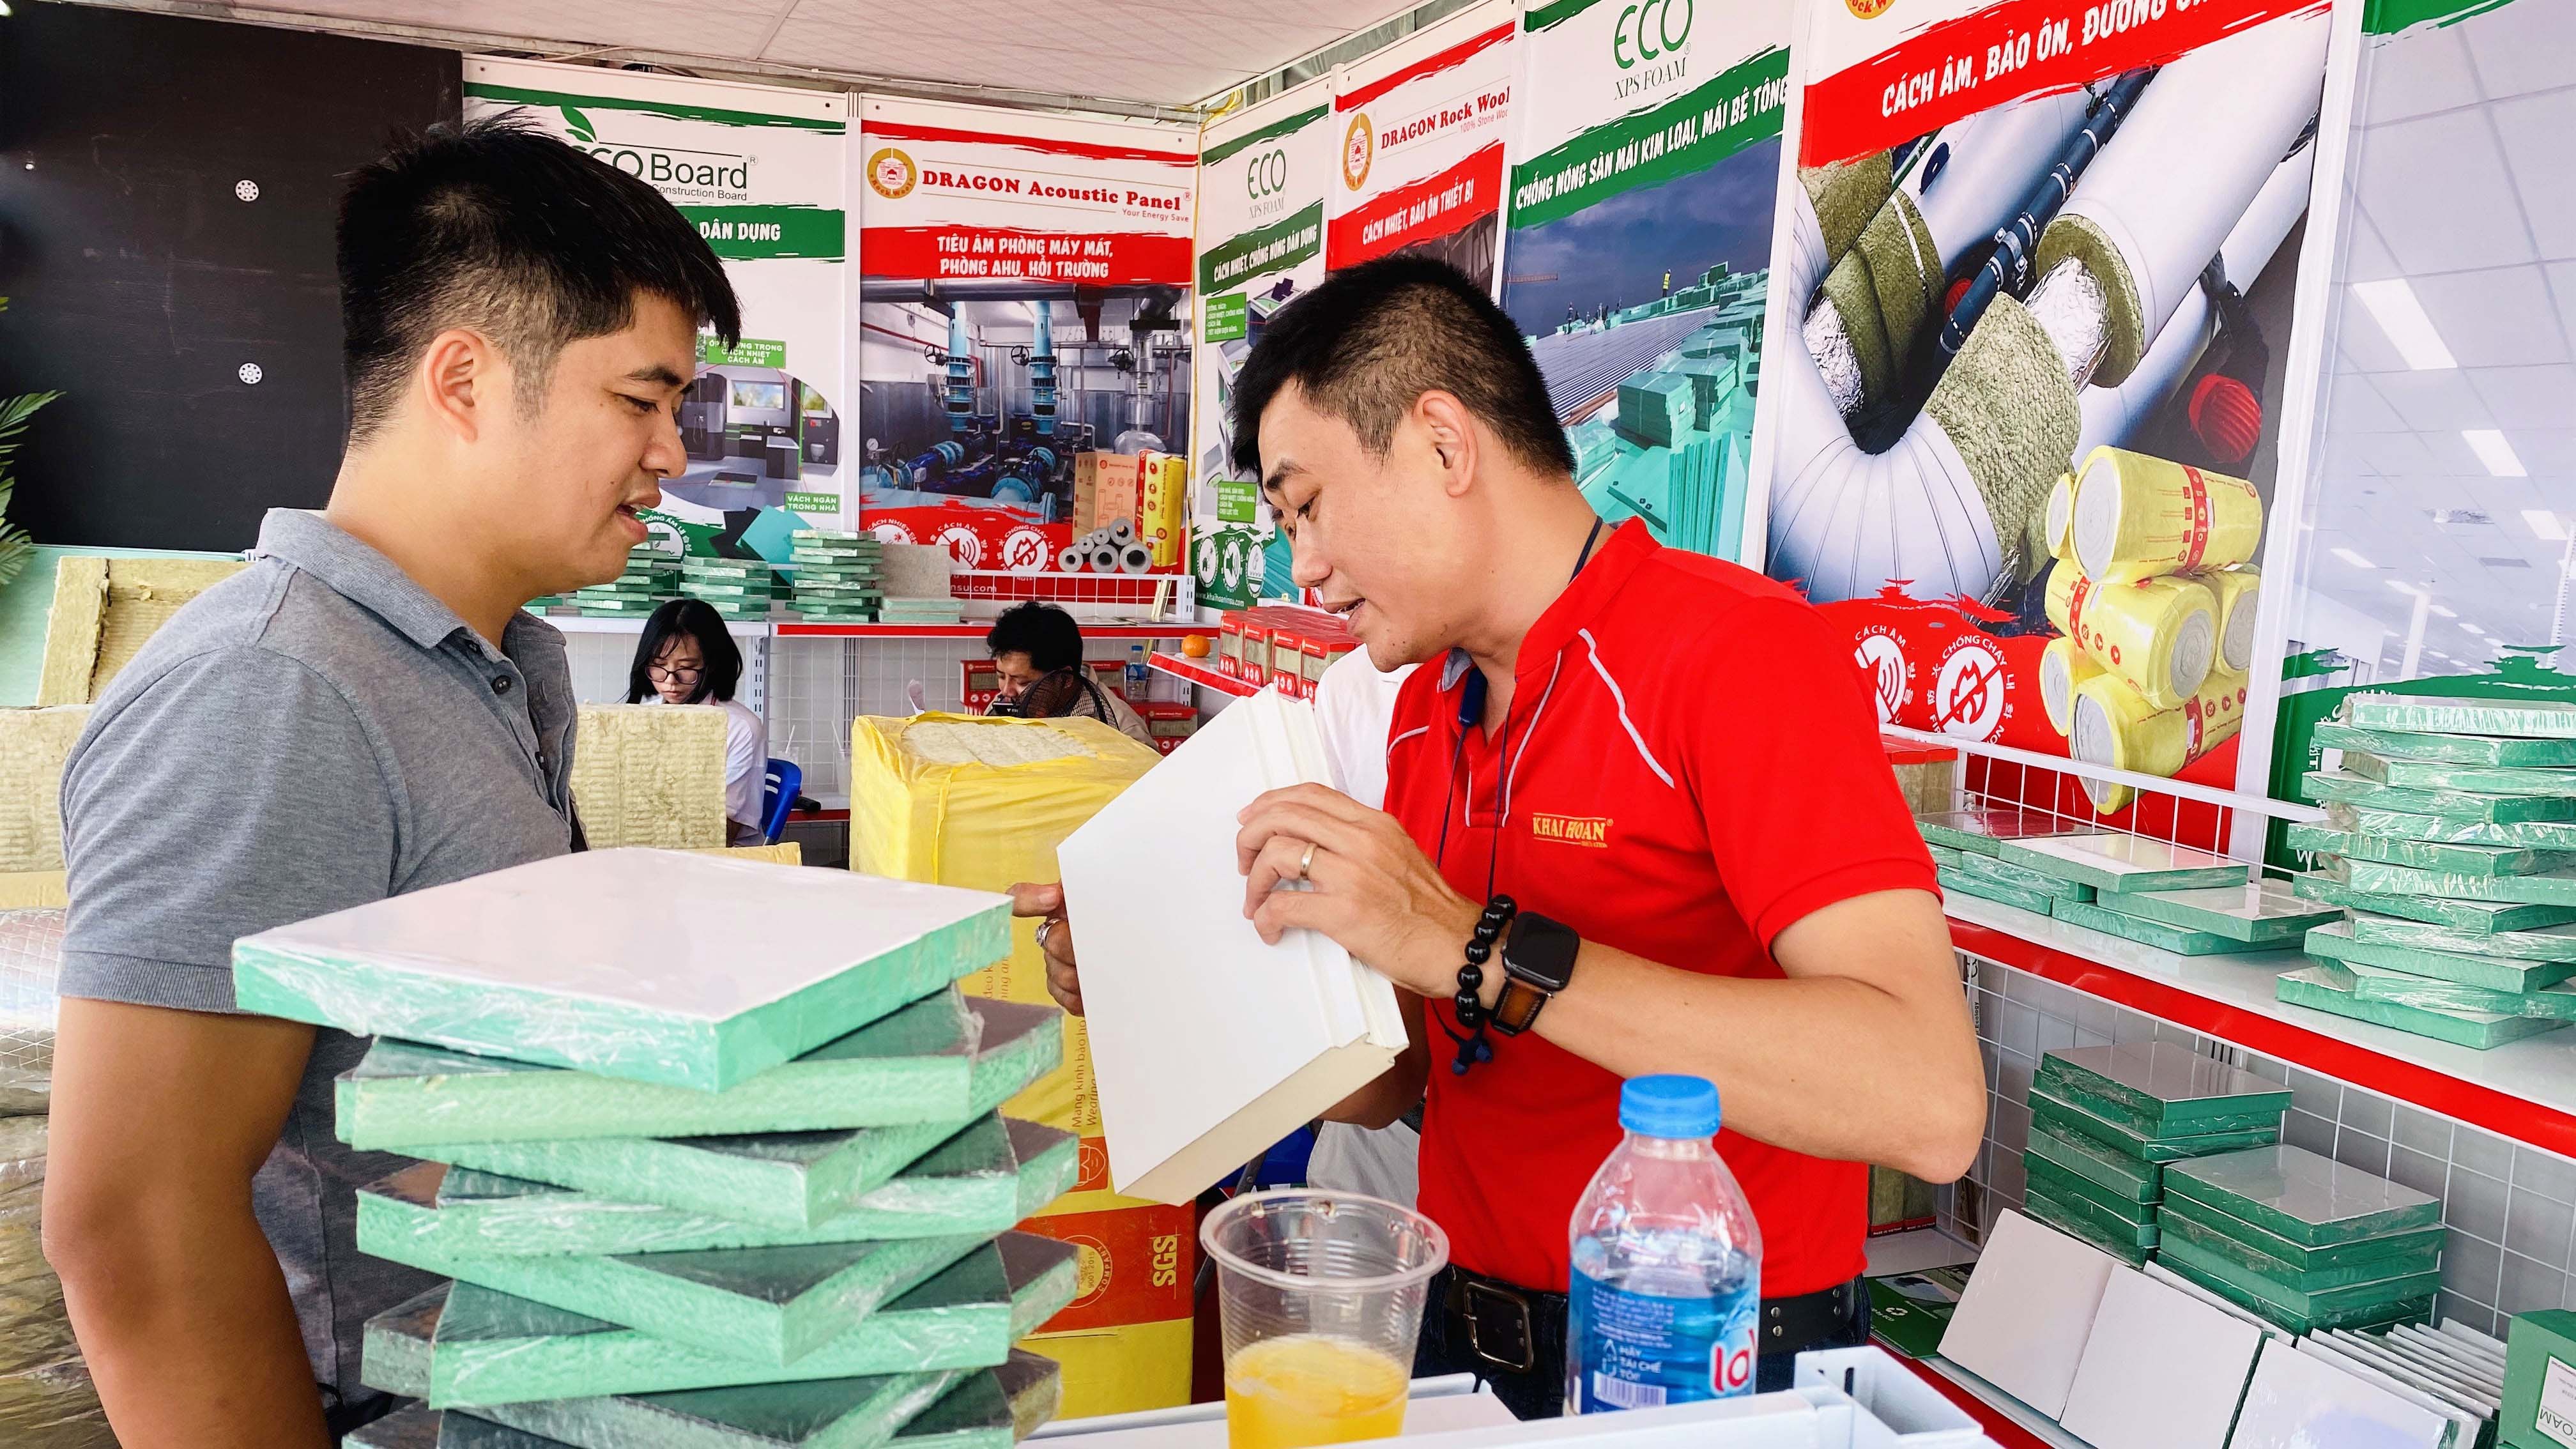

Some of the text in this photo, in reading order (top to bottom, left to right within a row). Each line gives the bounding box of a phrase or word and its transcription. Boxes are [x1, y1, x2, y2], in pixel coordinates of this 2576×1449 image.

[1614, 57, 1686, 100] XPS FOAM
[1882, 68, 1936, 118] CÁCH
[1939, 55, 1978, 98] ÂM,
[1984, 29, 2031, 81] BẢO
[2036, 17, 2073, 62] ÔN,
[1381, 86, 1510, 149] DRAGON Rock Wool
[1460, 119, 1476, 133] 100%
[1478, 114, 1494, 127] Stone
[1515, 77, 1788, 211] CHỐNG NÓNG SÀN MÁI KIM LOẠI, MÁI BÊ TÔNG
[651, 153, 747, 188] Board
[1248, 150, 1285, 199] ECO
[718, 192, 747, 201] Board
[923, 171, 1180, 210] DRAGON Acoustic Panel
[1263, 197, 1284, 215] FOAM
[1142, 211, 1169, 220] Energy
[1363, 176, 1475, 245] CÁCH NHIỆT, BẢO ÔN THIẾT BỊ
[700, 218, 781, 243] DÂN DỤNG
[937, 233, 1113, 257] TIÊU ÂM PHÒNG MÁY MÁT,
[940, 256, 987, 275] PHÒNG
[992, 260, 1024, 277] AHU,
[1055, 259, 1108, 278] TRƯỜNG
[1214, 224, 1317, 282] CÁCH NHIỆT, CHỐNG NÓNG DÂN DỤNG
[755, 343, 783, 351] TRONG
[788, 494, 810, 503] VÁCH
[820, 503, 836, 512] NHÀ
[643, 515, 665, 523] HỐNG
[1855, 625, 1906, 647] CÁCH ÂM
[1942, 634, 2007, 666] CHỐNG CHÁY
[1533, 817, 1606, 841] KHAI HOAN
[1072, 1094, 1085, 1127] Mang
[1097, 1246, 1111, 1291] COMPANY
[1153, 1236, 1177, 1287] SGS
[2540, 1409, 2576, 1440] OAM
